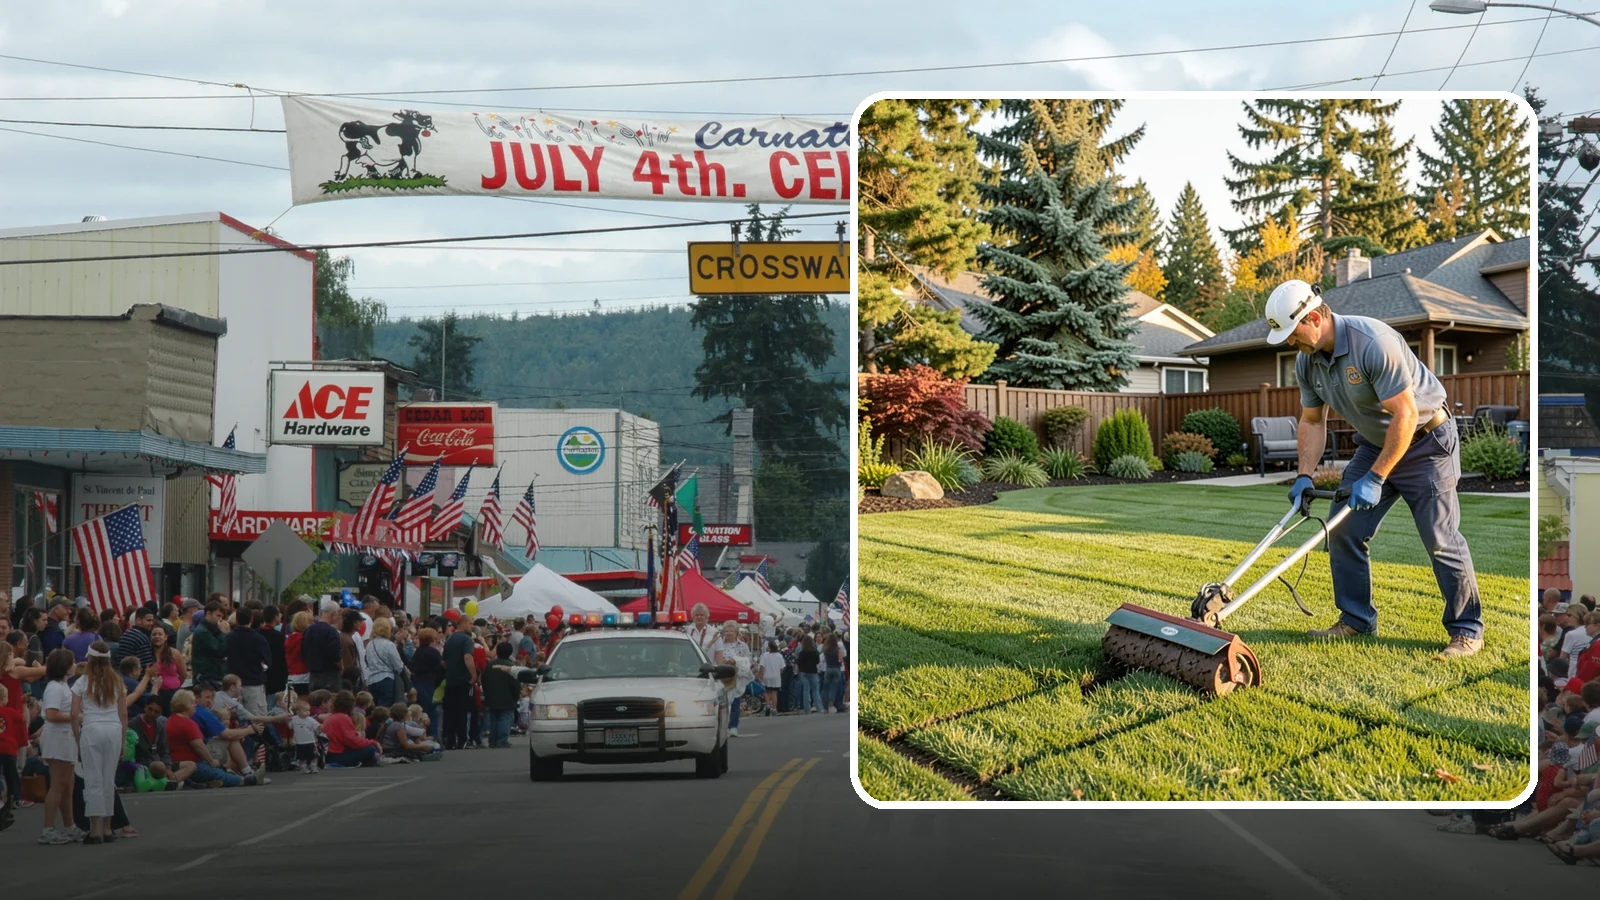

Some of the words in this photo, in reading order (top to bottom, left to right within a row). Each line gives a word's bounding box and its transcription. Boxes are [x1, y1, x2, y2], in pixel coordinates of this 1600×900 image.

[481, 140, 605, 192] JULY
[632, 150, 746, 198] 4th.
[697, 254, 851, 280] CROSSWA
[282, 380, 374, 420] ACE
[406, 409, 453, 422] CEDAR
[283, 421, 371, 436] Hardware
[353, 467, 385, 480] Simpl
[95, 485, 125, 495] Vincent
[126, 486, 136, 495] de
[137, 486, 155, 495] Paul
[81, 503, 154, 522] THT
[688, 526, 741, 535] CRNATION
[699, 535, 730, 543] GLASS
